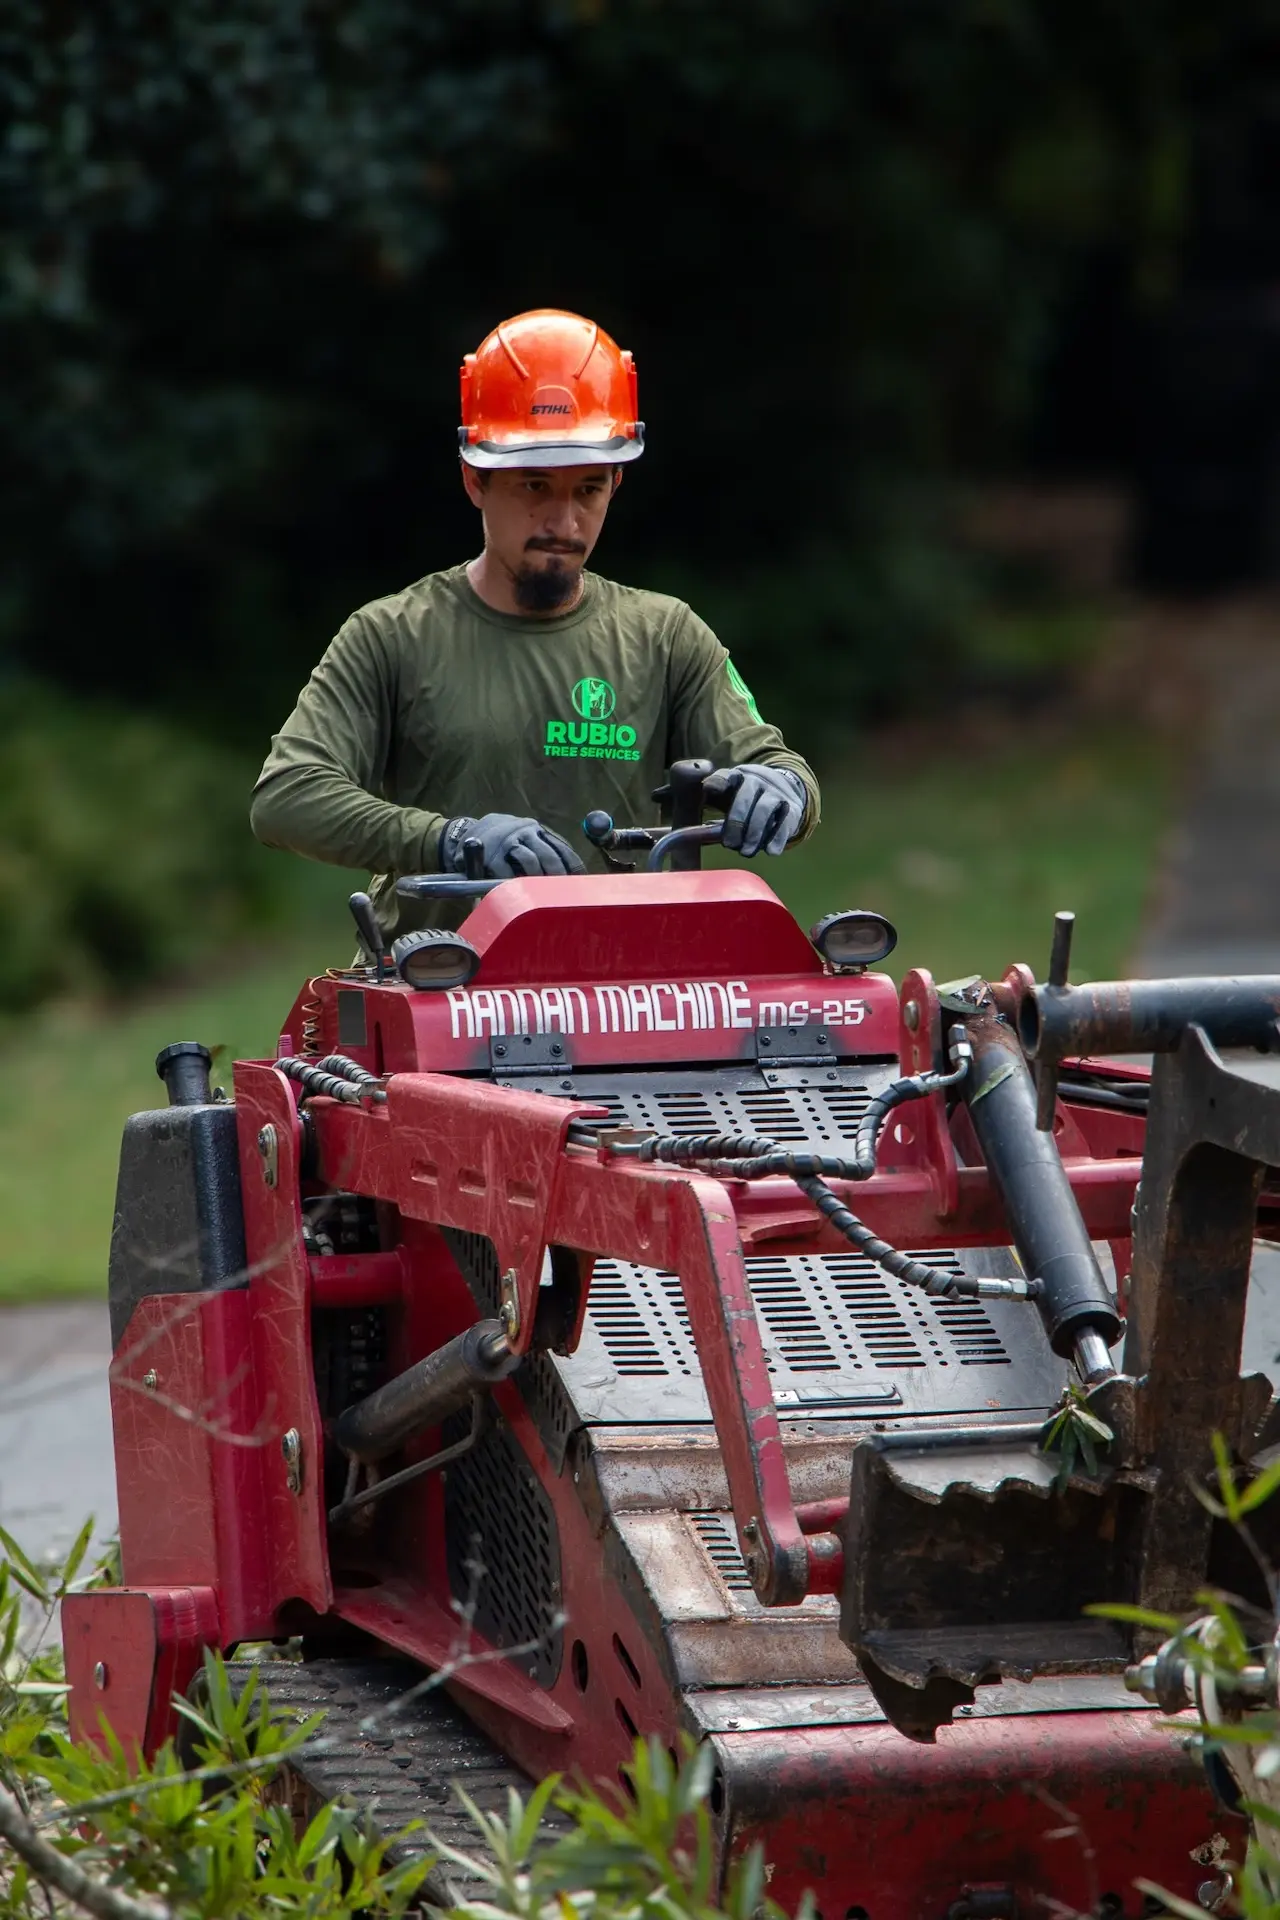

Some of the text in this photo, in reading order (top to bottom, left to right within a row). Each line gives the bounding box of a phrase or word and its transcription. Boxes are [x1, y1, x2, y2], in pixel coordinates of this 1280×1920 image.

[530, 404, 571, 415] STIHL
[547, 721, 637, 747] RUBIO
[543, 745, 640, 761] TREE SERVICES
[446, 986, 590, 1038] HANNAN
[593, 981, 753, 1033] MACHINE
